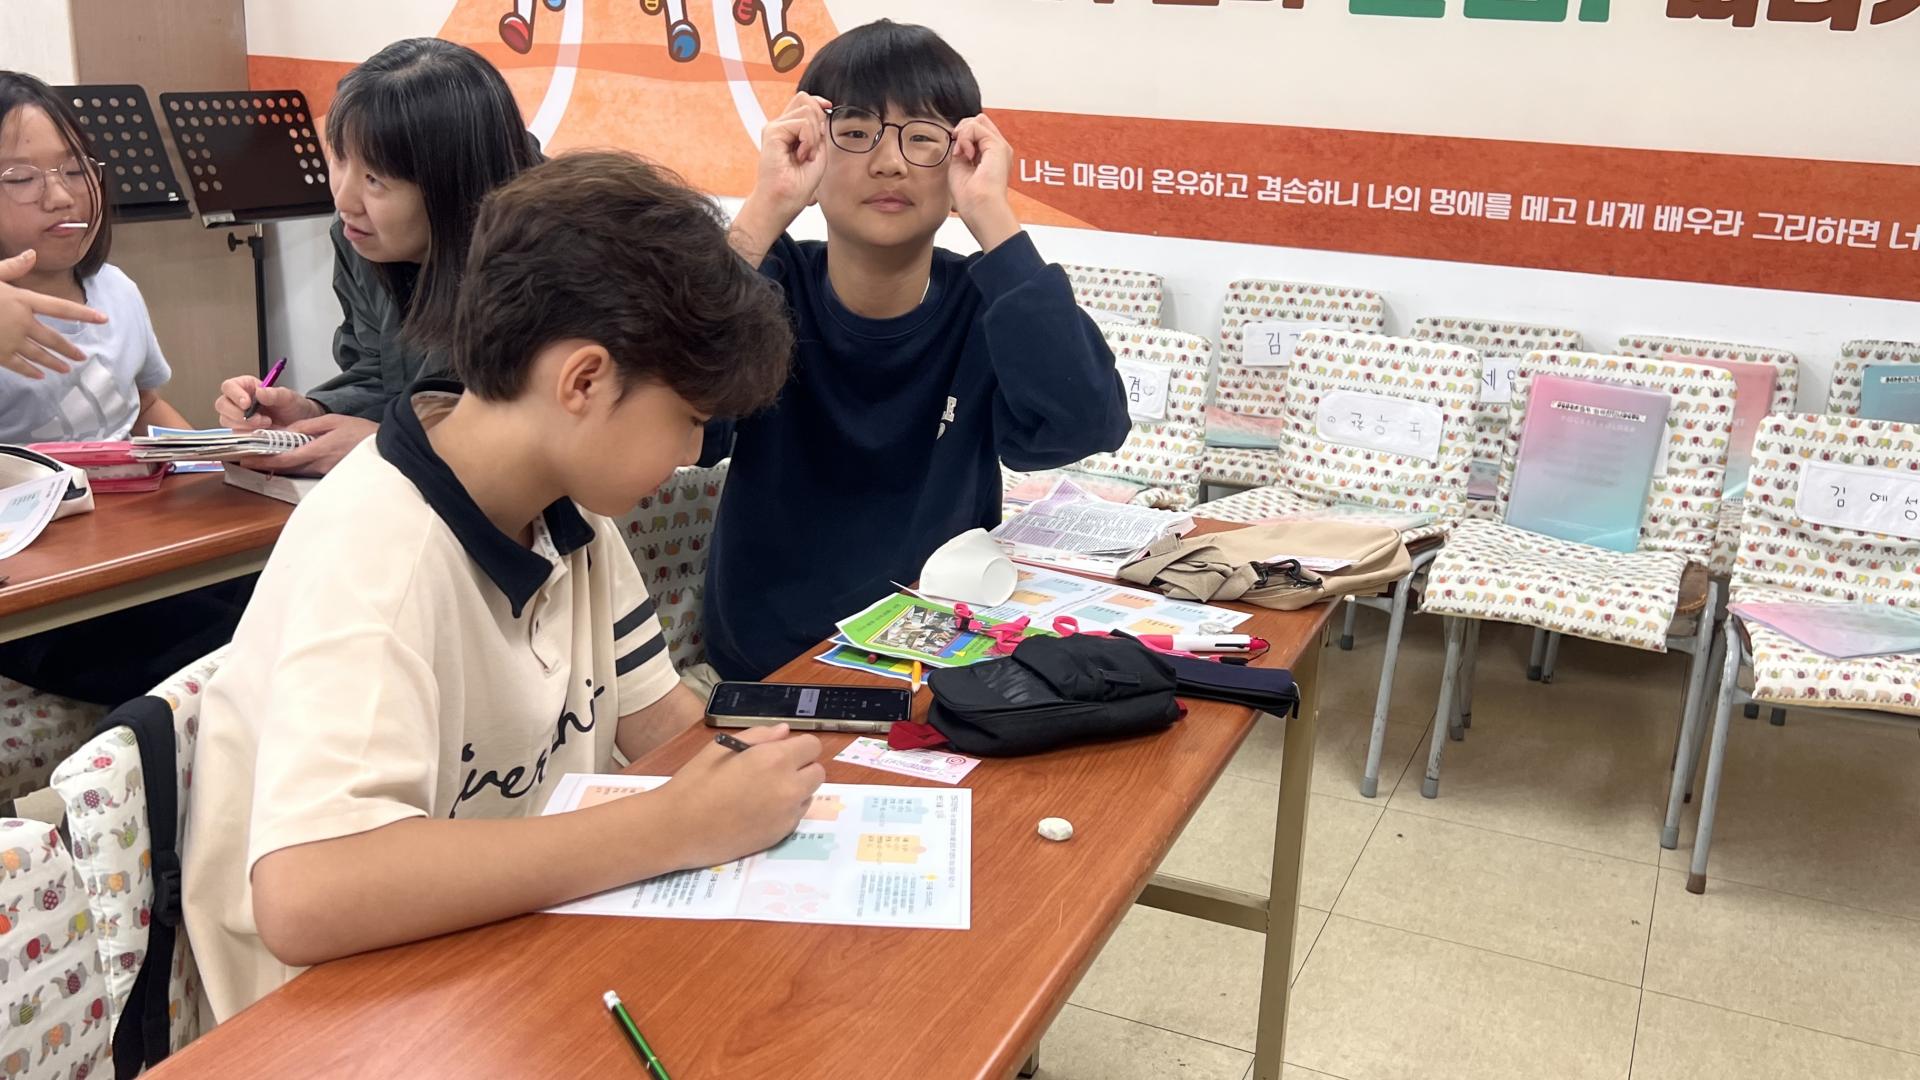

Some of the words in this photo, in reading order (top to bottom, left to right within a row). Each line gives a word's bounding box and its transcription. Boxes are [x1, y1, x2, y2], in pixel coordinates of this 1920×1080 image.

[1019, 158, 1066, 186] 나는
[1072, 162, 1143, 191] 마음이
[1151, 168, 1249, 199] 온유하고
[1256, 175, 1359, 207] 겸손하니
[1367, 183, 1421, 212] 나의
[1429, 188, 1512, 221] 멍에를
[1520, 195, 1578, 224] 메고
[1586, 200, 1646, 230] 내게
[1653, 204, 1745, 238] 배우라
[1752, 212, 1881, 248] 그리하면
